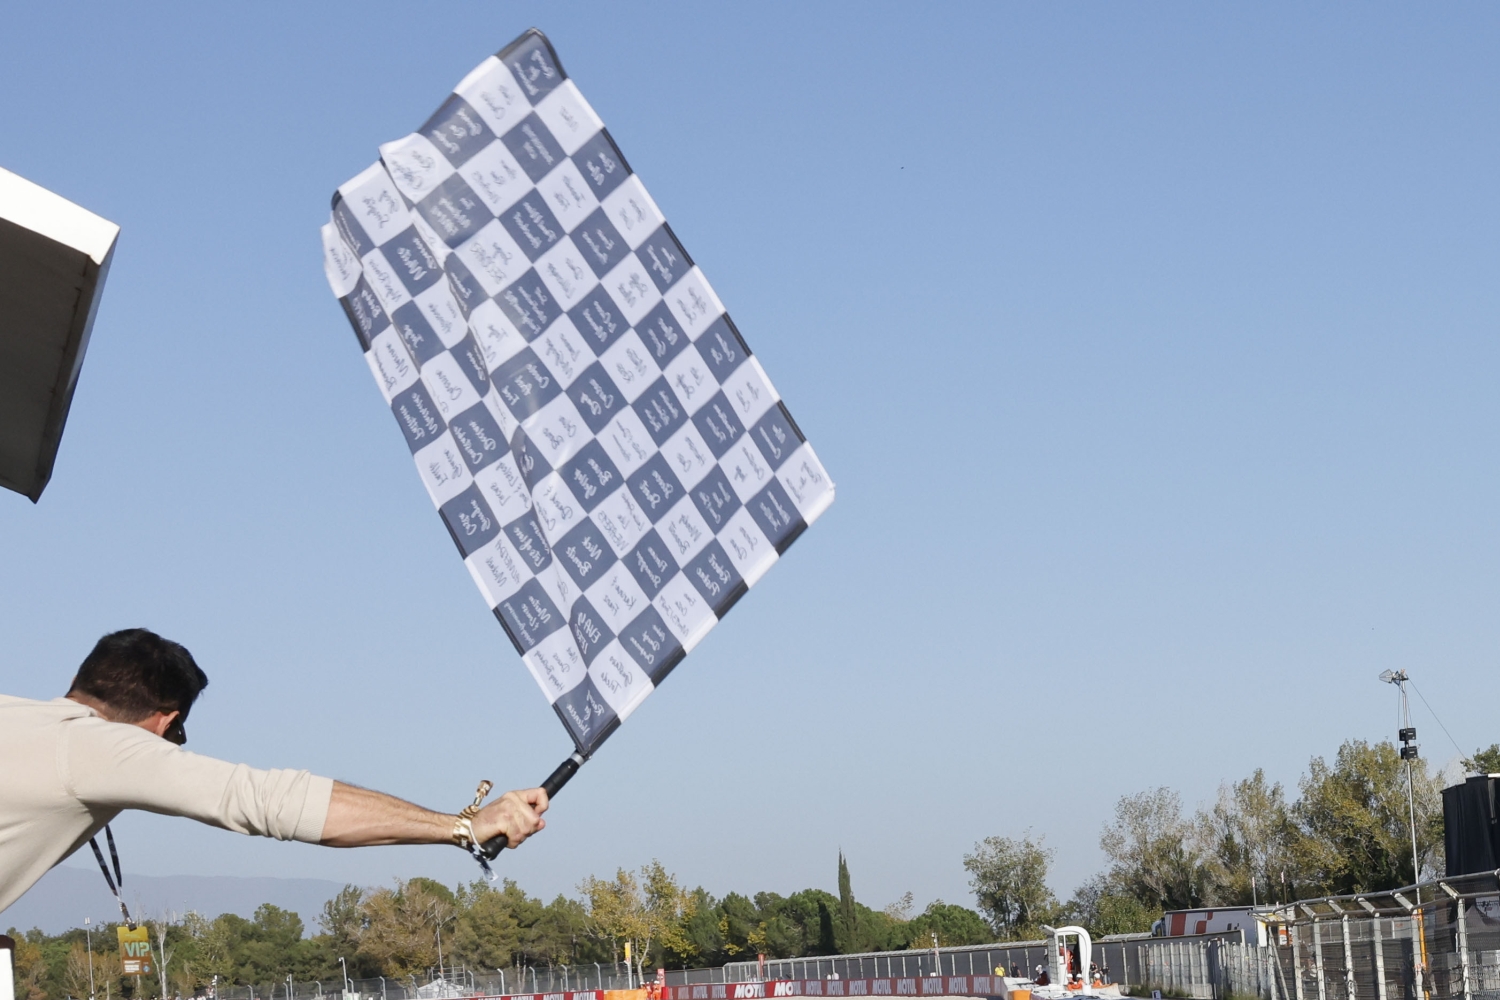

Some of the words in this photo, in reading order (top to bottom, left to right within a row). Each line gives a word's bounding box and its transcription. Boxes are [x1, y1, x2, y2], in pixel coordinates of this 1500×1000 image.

[124, 942, 150, 957] VIP
[734, 984, 765, 999] MOTUL
[774, 980, 801, 996] MOTUL
